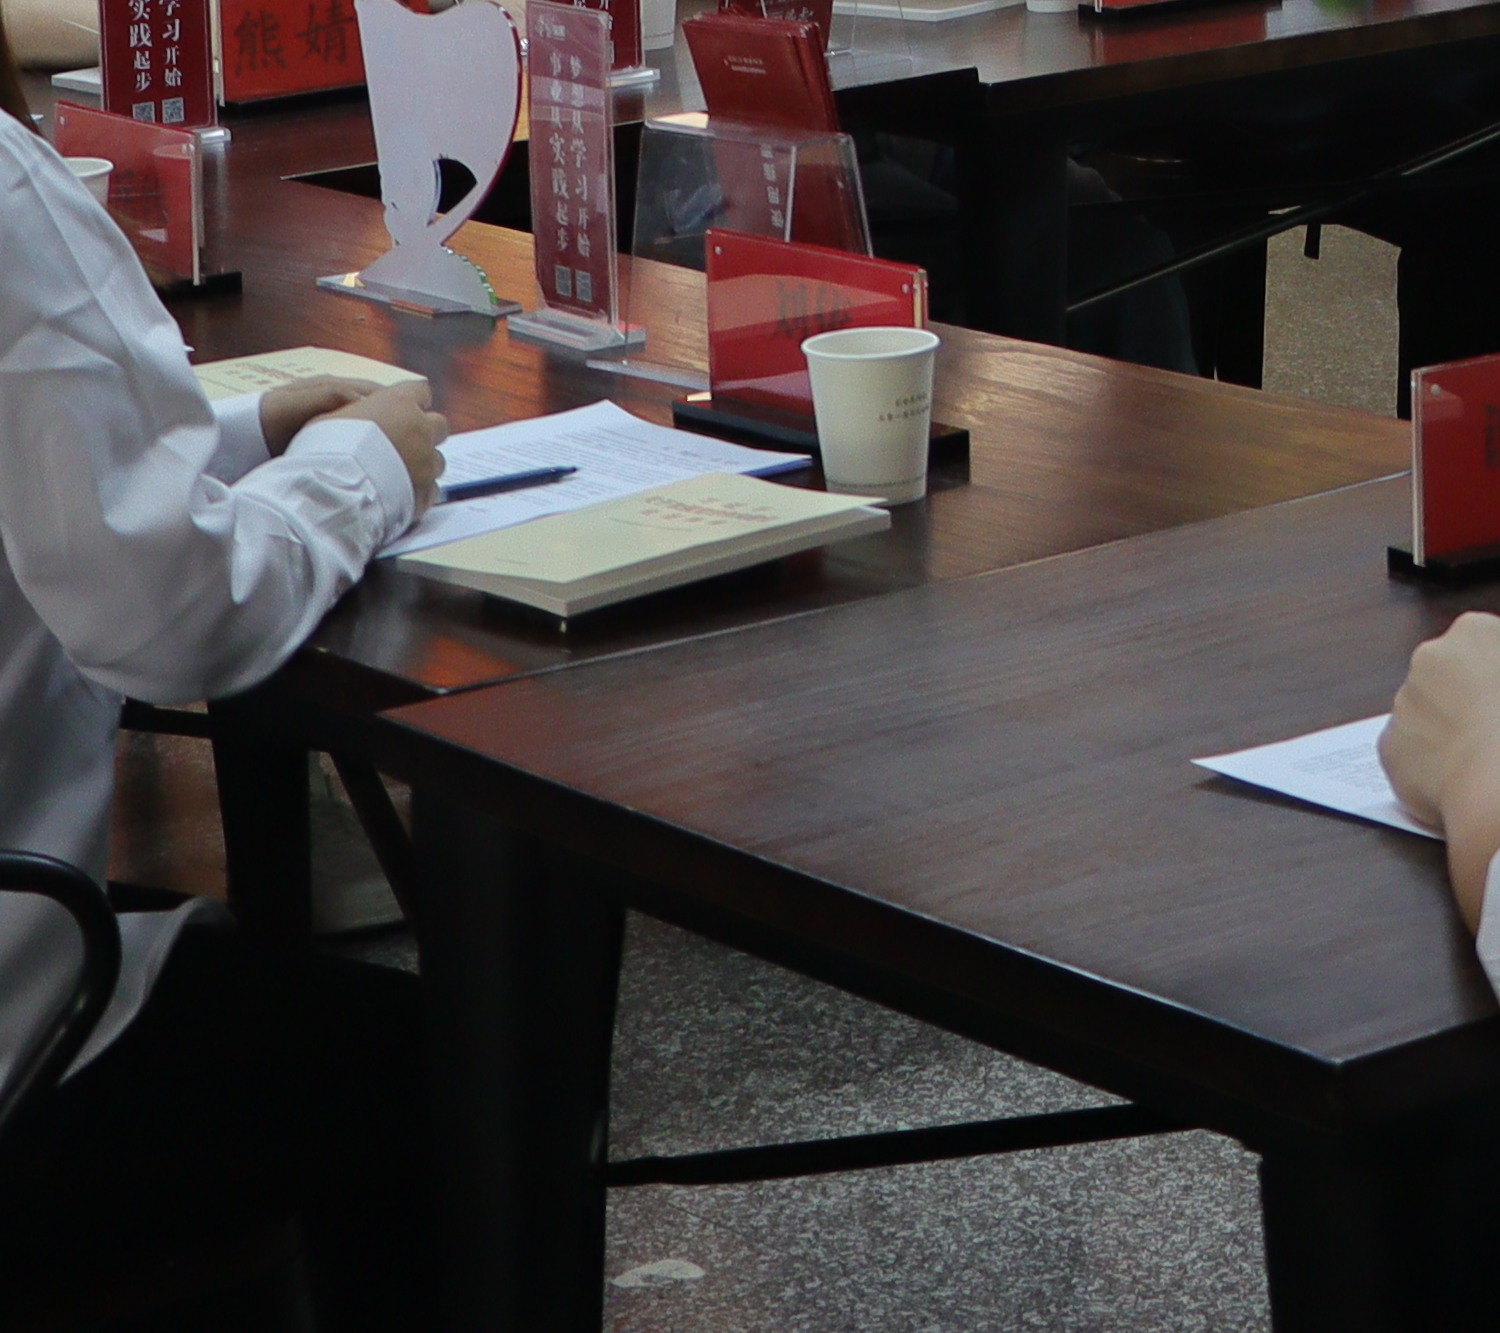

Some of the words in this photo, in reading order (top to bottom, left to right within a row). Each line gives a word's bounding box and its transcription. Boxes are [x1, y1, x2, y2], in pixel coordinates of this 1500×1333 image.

[549, 53, 570, 252] 事业从实践起步
[570, 55, 591, 259] 梦想从学习开始
